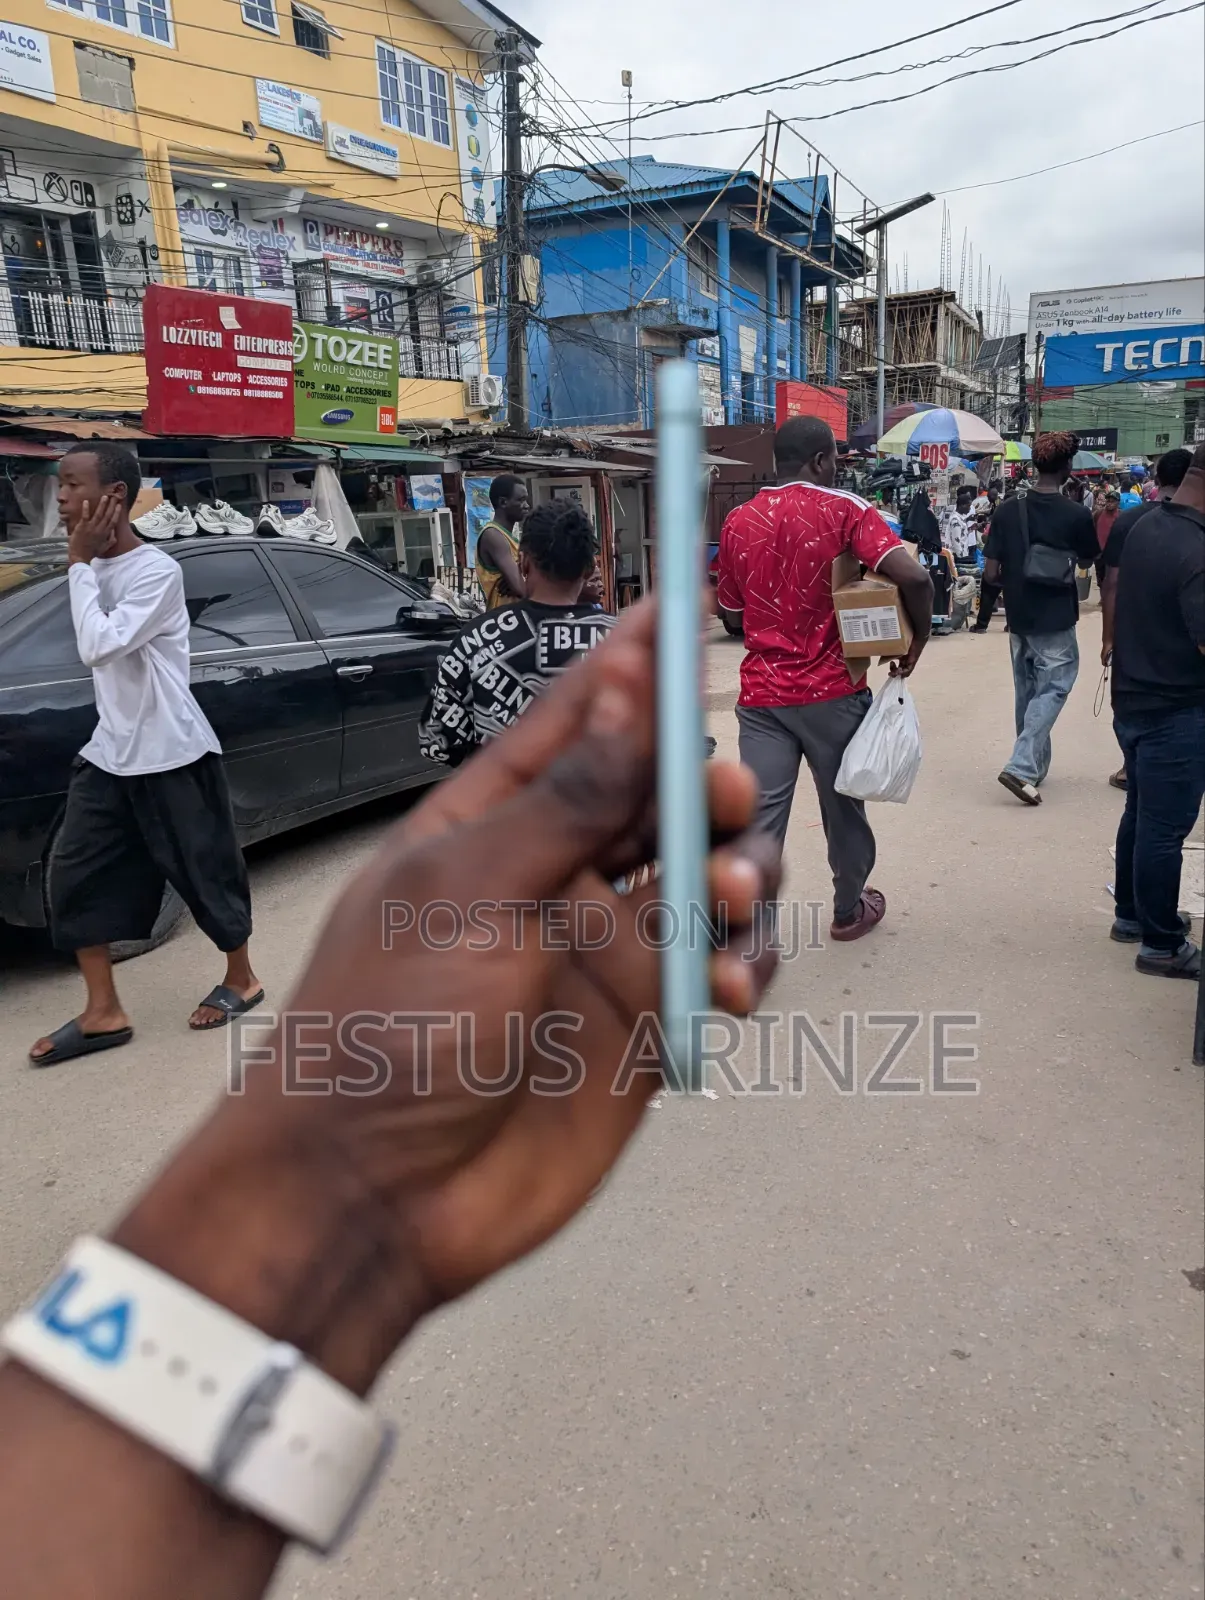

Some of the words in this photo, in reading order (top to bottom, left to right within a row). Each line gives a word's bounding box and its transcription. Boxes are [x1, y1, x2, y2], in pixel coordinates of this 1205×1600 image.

[18, 36, 41, 53] CO.
[5, 46, 26, 58] Gadget
[27, 53, 42, 63] Sales
[267, 83, 302, 102] LAKESIDE
[177, 207, 231, 231] ealex
[234, 221, 297, 251] Realex
[1035, 321, 1054, 329] Under
[1056, 318, 1061, 327] 1
[1063, 318, 1074, 327] kg
[1091, 313, 1125, 324] all-day
[1127, 309, 1164, 320] battery
[1165, 307, 1182, 316] life
[1037, 311, 1058, 320] ASUS
[1060, 308, 1093, 318] Zenbook
[1095, 306, 1109, 314] A14
[162, 325, 223, 348] LOZZYTECH
[310, 332, 393, 370] TOZEE
[239, 356, 291, 370] COMPUTER
[313, 362, 346, 375] WOLRD
[349, 367, 389, 380] CONCEPT
[164, 367, 202, 381] COMPUTER
[213, 371, 241, 383] LAPTOPS
[248, 375, 288, 387] ACCESSORIES
[295, 369, 305, 377] NE
[295, 380, 316, 390] TOPS
[324, 384, 341, 392] IPAD
[346, 386, 392, 398] ACCESSORIES
[327, 412, 351, 421] SAMSUNG
[381, 413, 394, 426] JBL
[921, 444, 948, 470] POS
[554, 626, 612, 650] BLN
[477, 663, 534, 716] BLN
